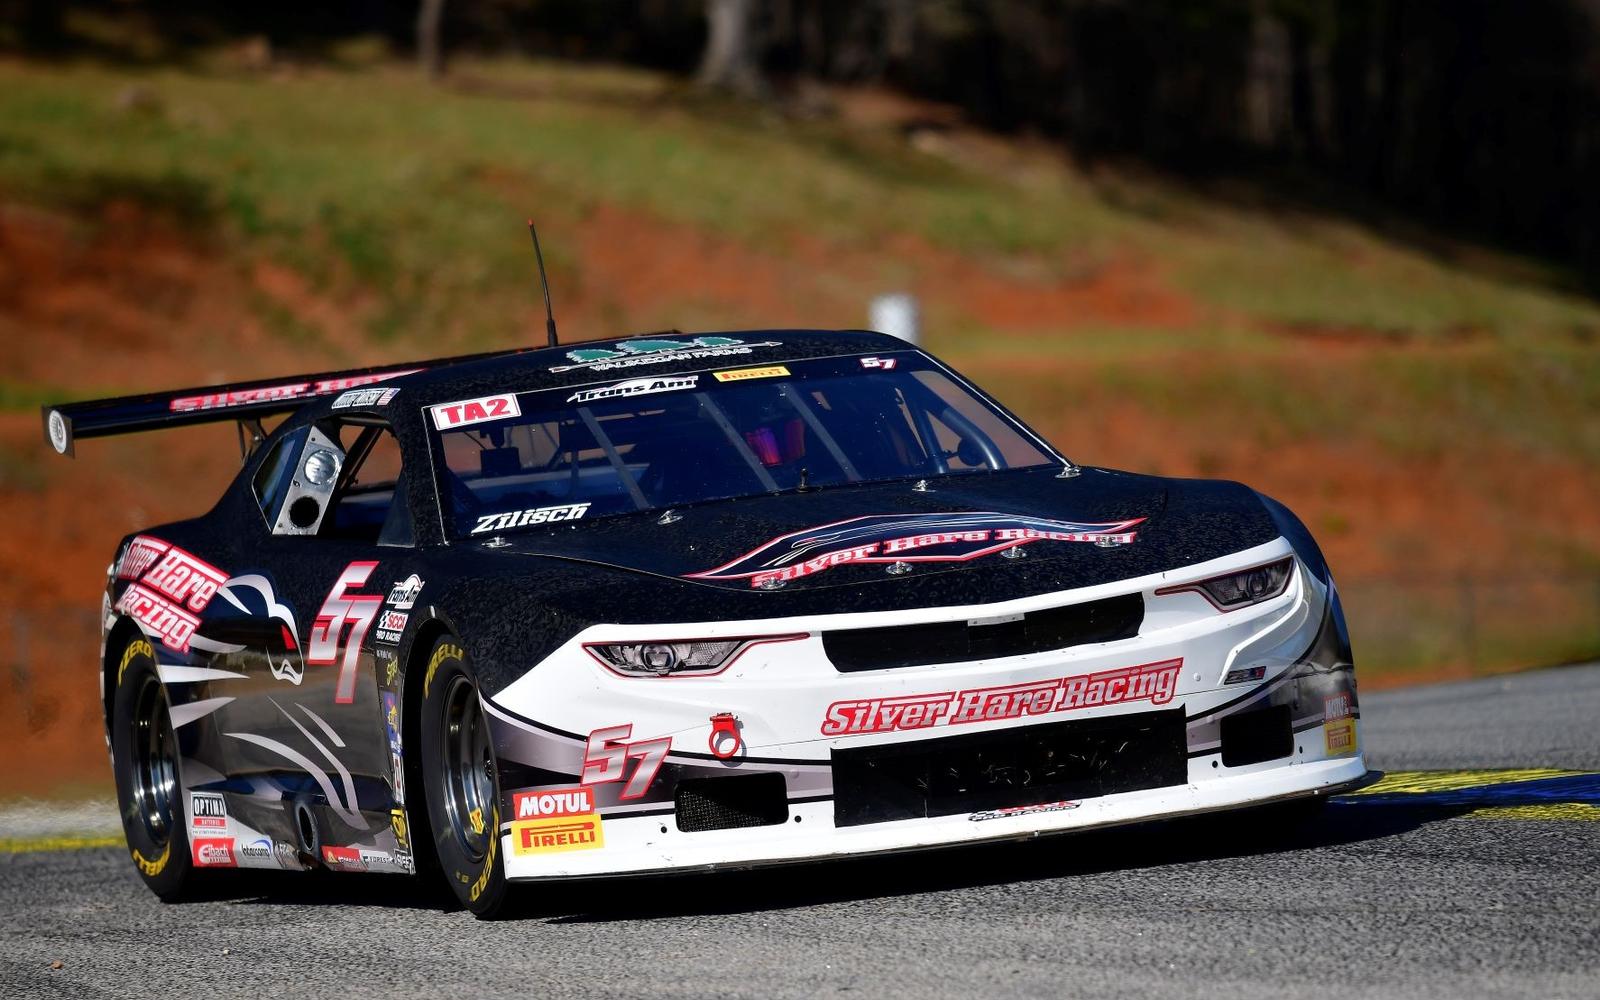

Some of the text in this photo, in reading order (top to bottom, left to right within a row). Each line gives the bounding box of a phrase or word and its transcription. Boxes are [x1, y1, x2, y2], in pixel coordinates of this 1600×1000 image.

[859, 356, 896, 370] 57
[441, 398, 511, 424] TA2
[471, 503, 591, 533] Zilisch
[141, 547, 230, 613] Hare
[751, 543, 881, 588] Silver
[883, 530, 989, 554] Hare
[307, 560, 385, 704] 57
[424, 643, 464, 699] PIRELLI
[821, 691, 953, 736] Silver
[950, 680, 1063, 725] Hare
[1058, 657, 1184, 710] Racing
[580, 723, 673, 801] 57
[194, 797, 225, 816] OPTIMA
[519, 791, 591, 818] MOTUL
[520, 821, 596, 849] PIRELLI
